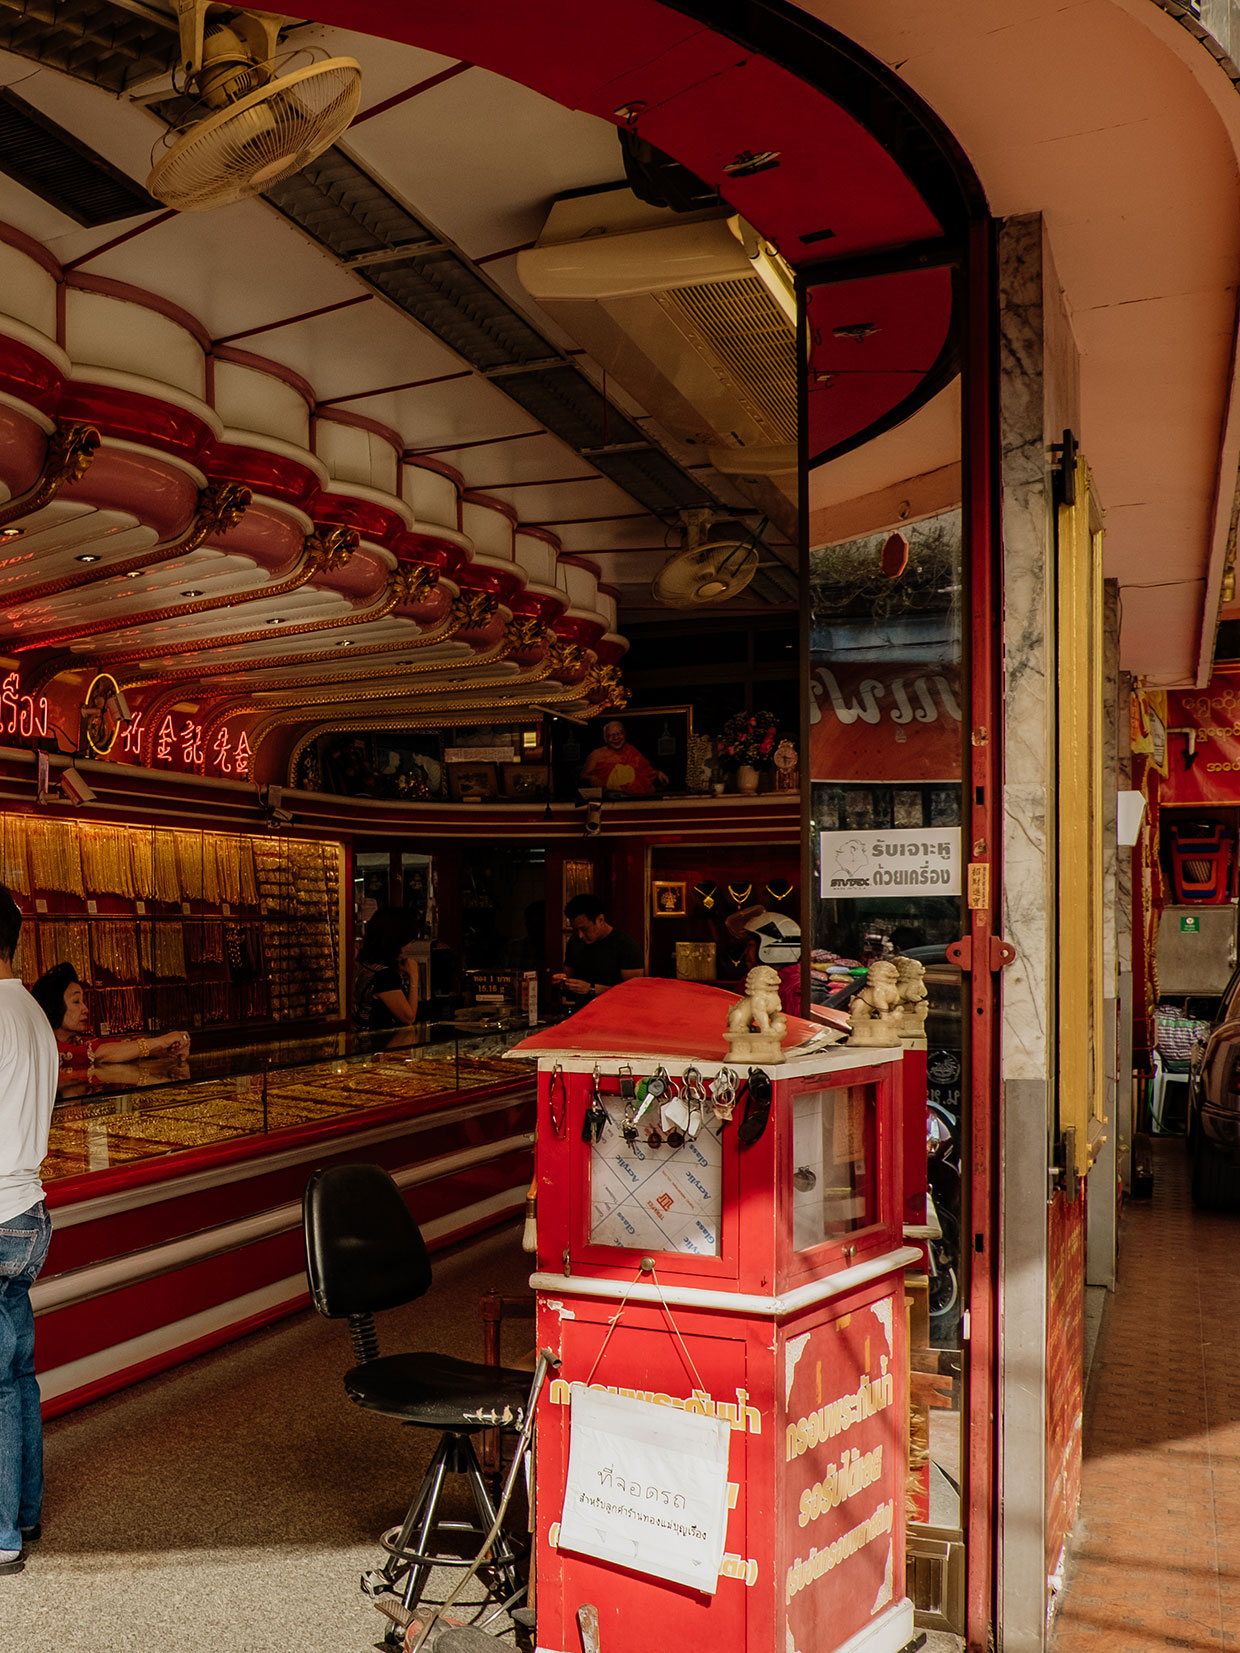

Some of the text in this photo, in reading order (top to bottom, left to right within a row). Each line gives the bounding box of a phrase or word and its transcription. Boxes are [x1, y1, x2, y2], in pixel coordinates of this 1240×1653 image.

[872, 839, 951, 860] รับเจาะหู
[830, 878, 870, 888] STUDEX
[872, 860, 951, 886] ด้วยเครื่อง
[689, 1144, 708, 1168] Glass
[615, 1155, 639, 1183] Acrylic
[685, 1171, 711, 1200] Acrylic
[617, 1212, 636, 1235] Glass
[695, 1220, 715, 1244] Glass
[598, 1464, 686, 1510] ที่จอดรถ
